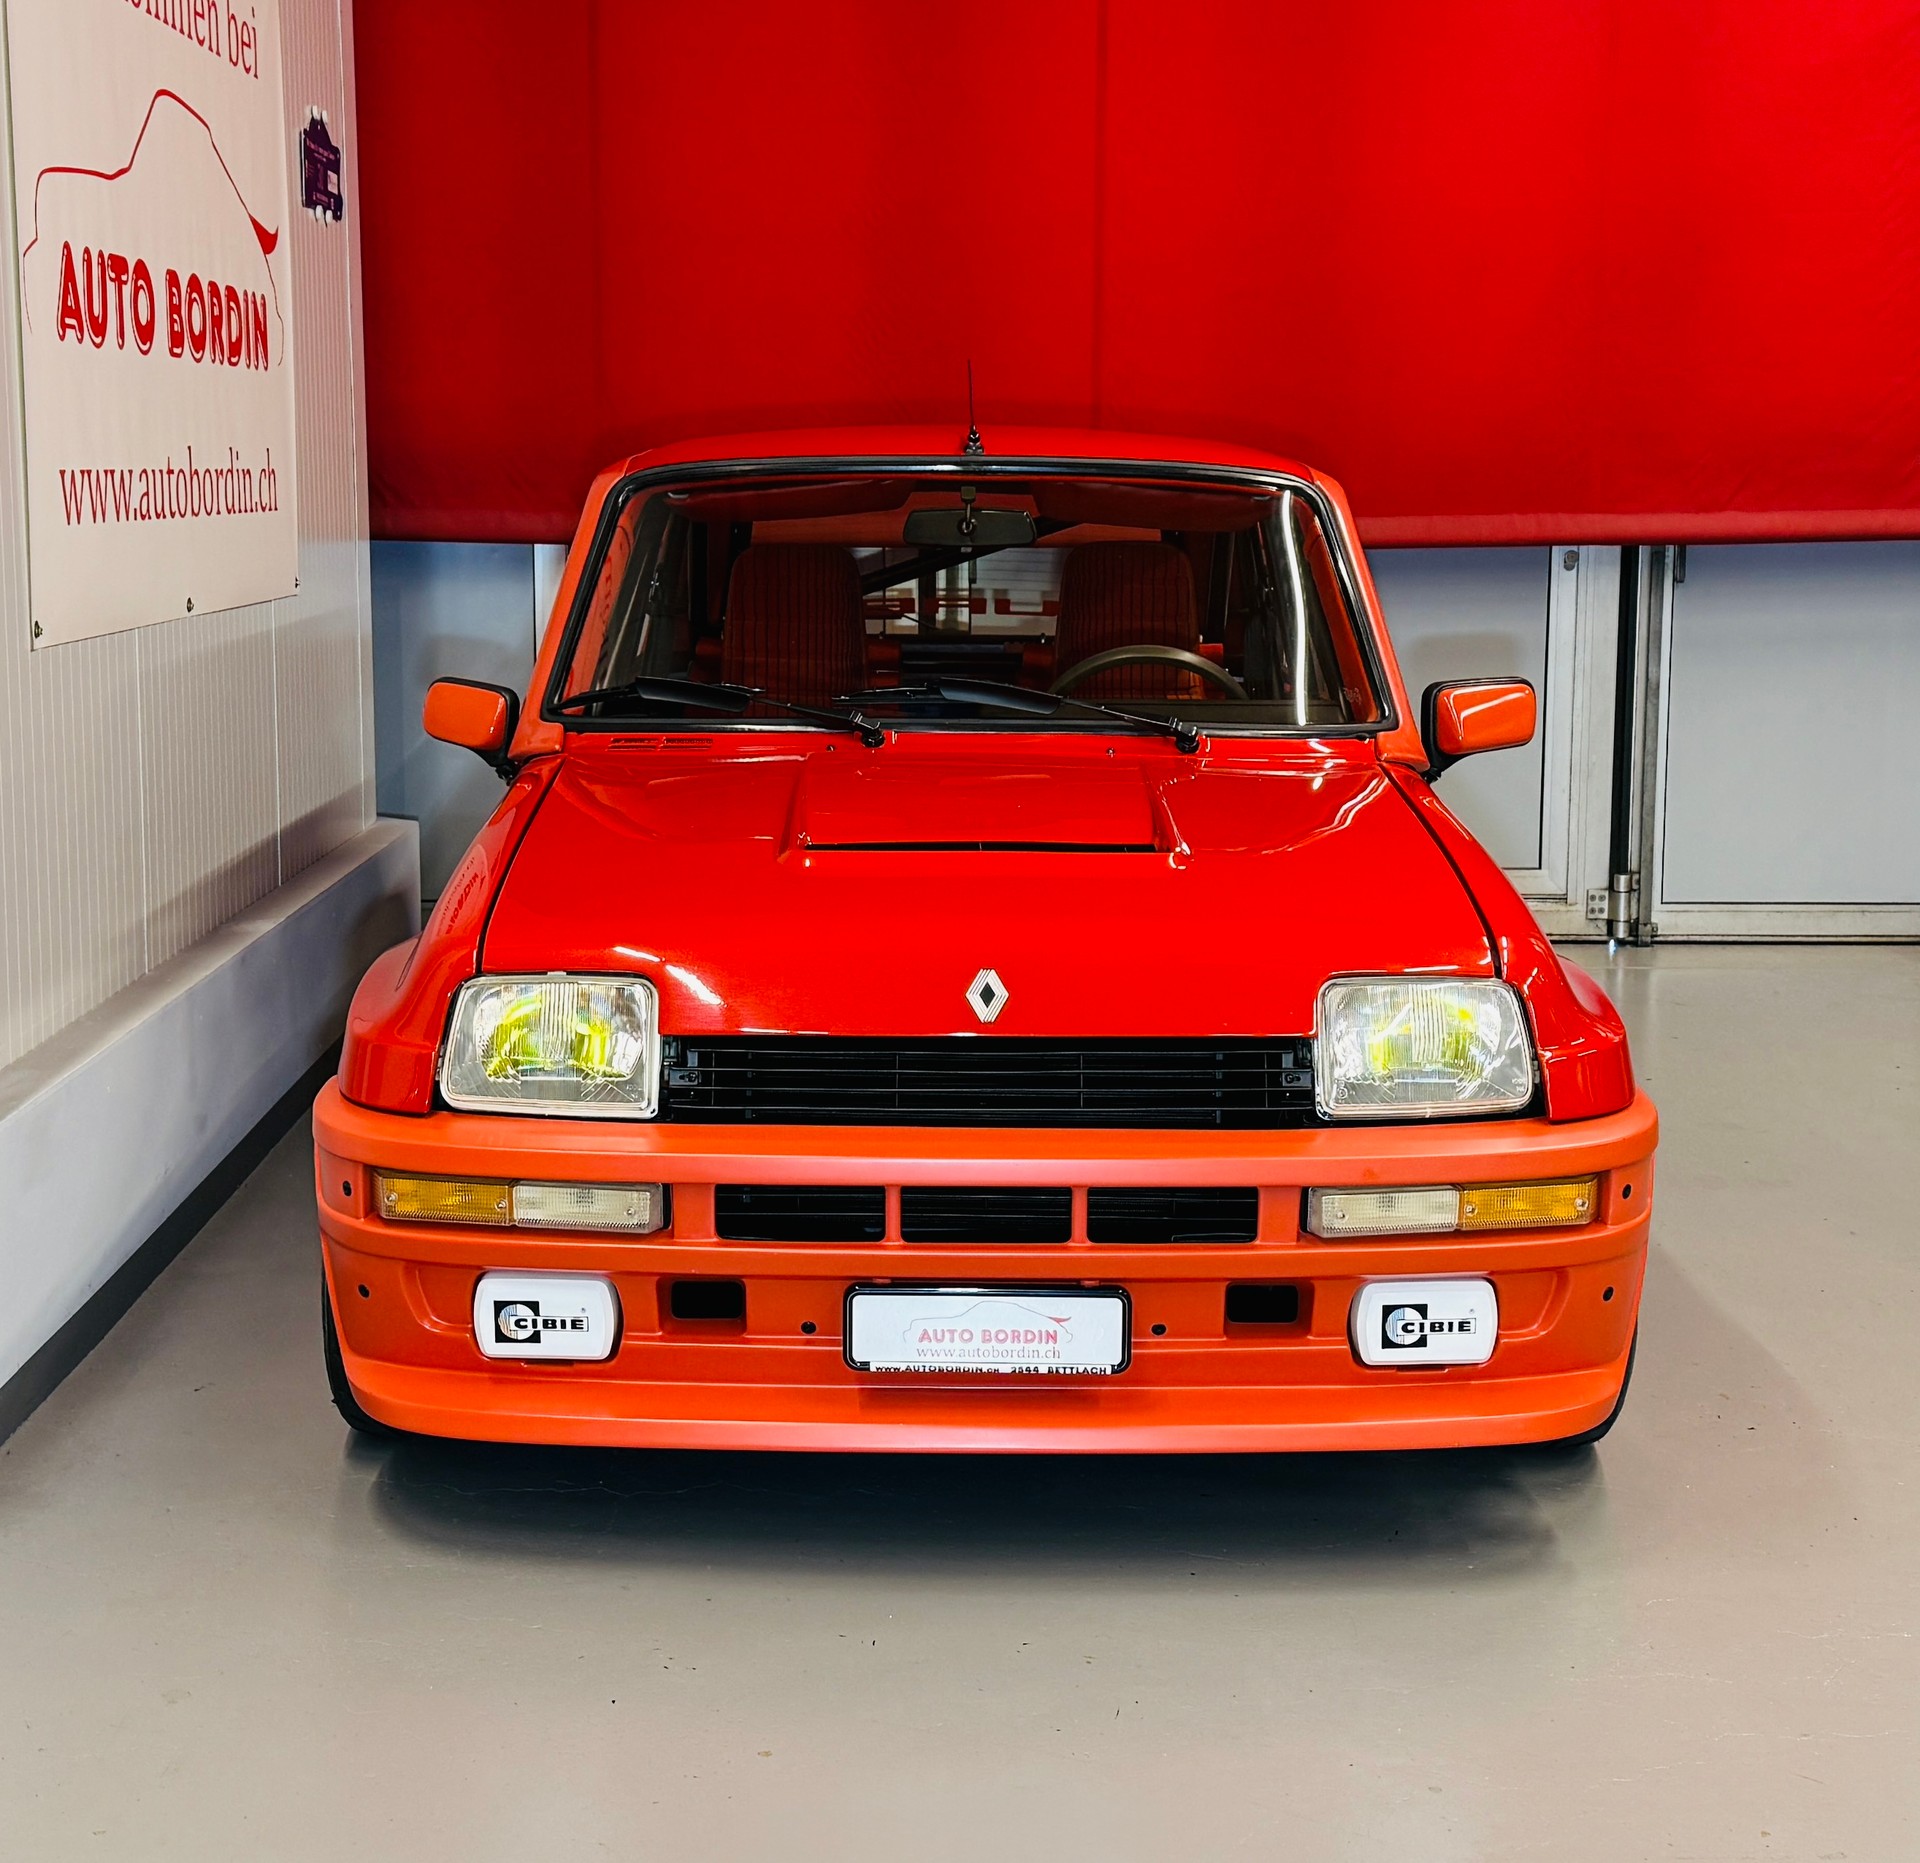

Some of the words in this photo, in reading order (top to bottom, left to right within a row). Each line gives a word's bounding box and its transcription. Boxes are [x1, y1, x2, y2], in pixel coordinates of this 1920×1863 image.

[226, 0, 259, 79] bei
[57, 240, 155, 355] AUTO
[165, 268, 269, 371] BORDIN
[59, 445, 279, 526] www.autobordin.ch
[514, 1318, 584, 1330] CIBIE
[1401, 1320, 1471, 1333] CIBIE
[918, 1328, 974, 1344] AUTO
[981, 1329, 1058, 1345] BORDIN
[916, 1346, 1061, 1359] www.autobordin.ch
